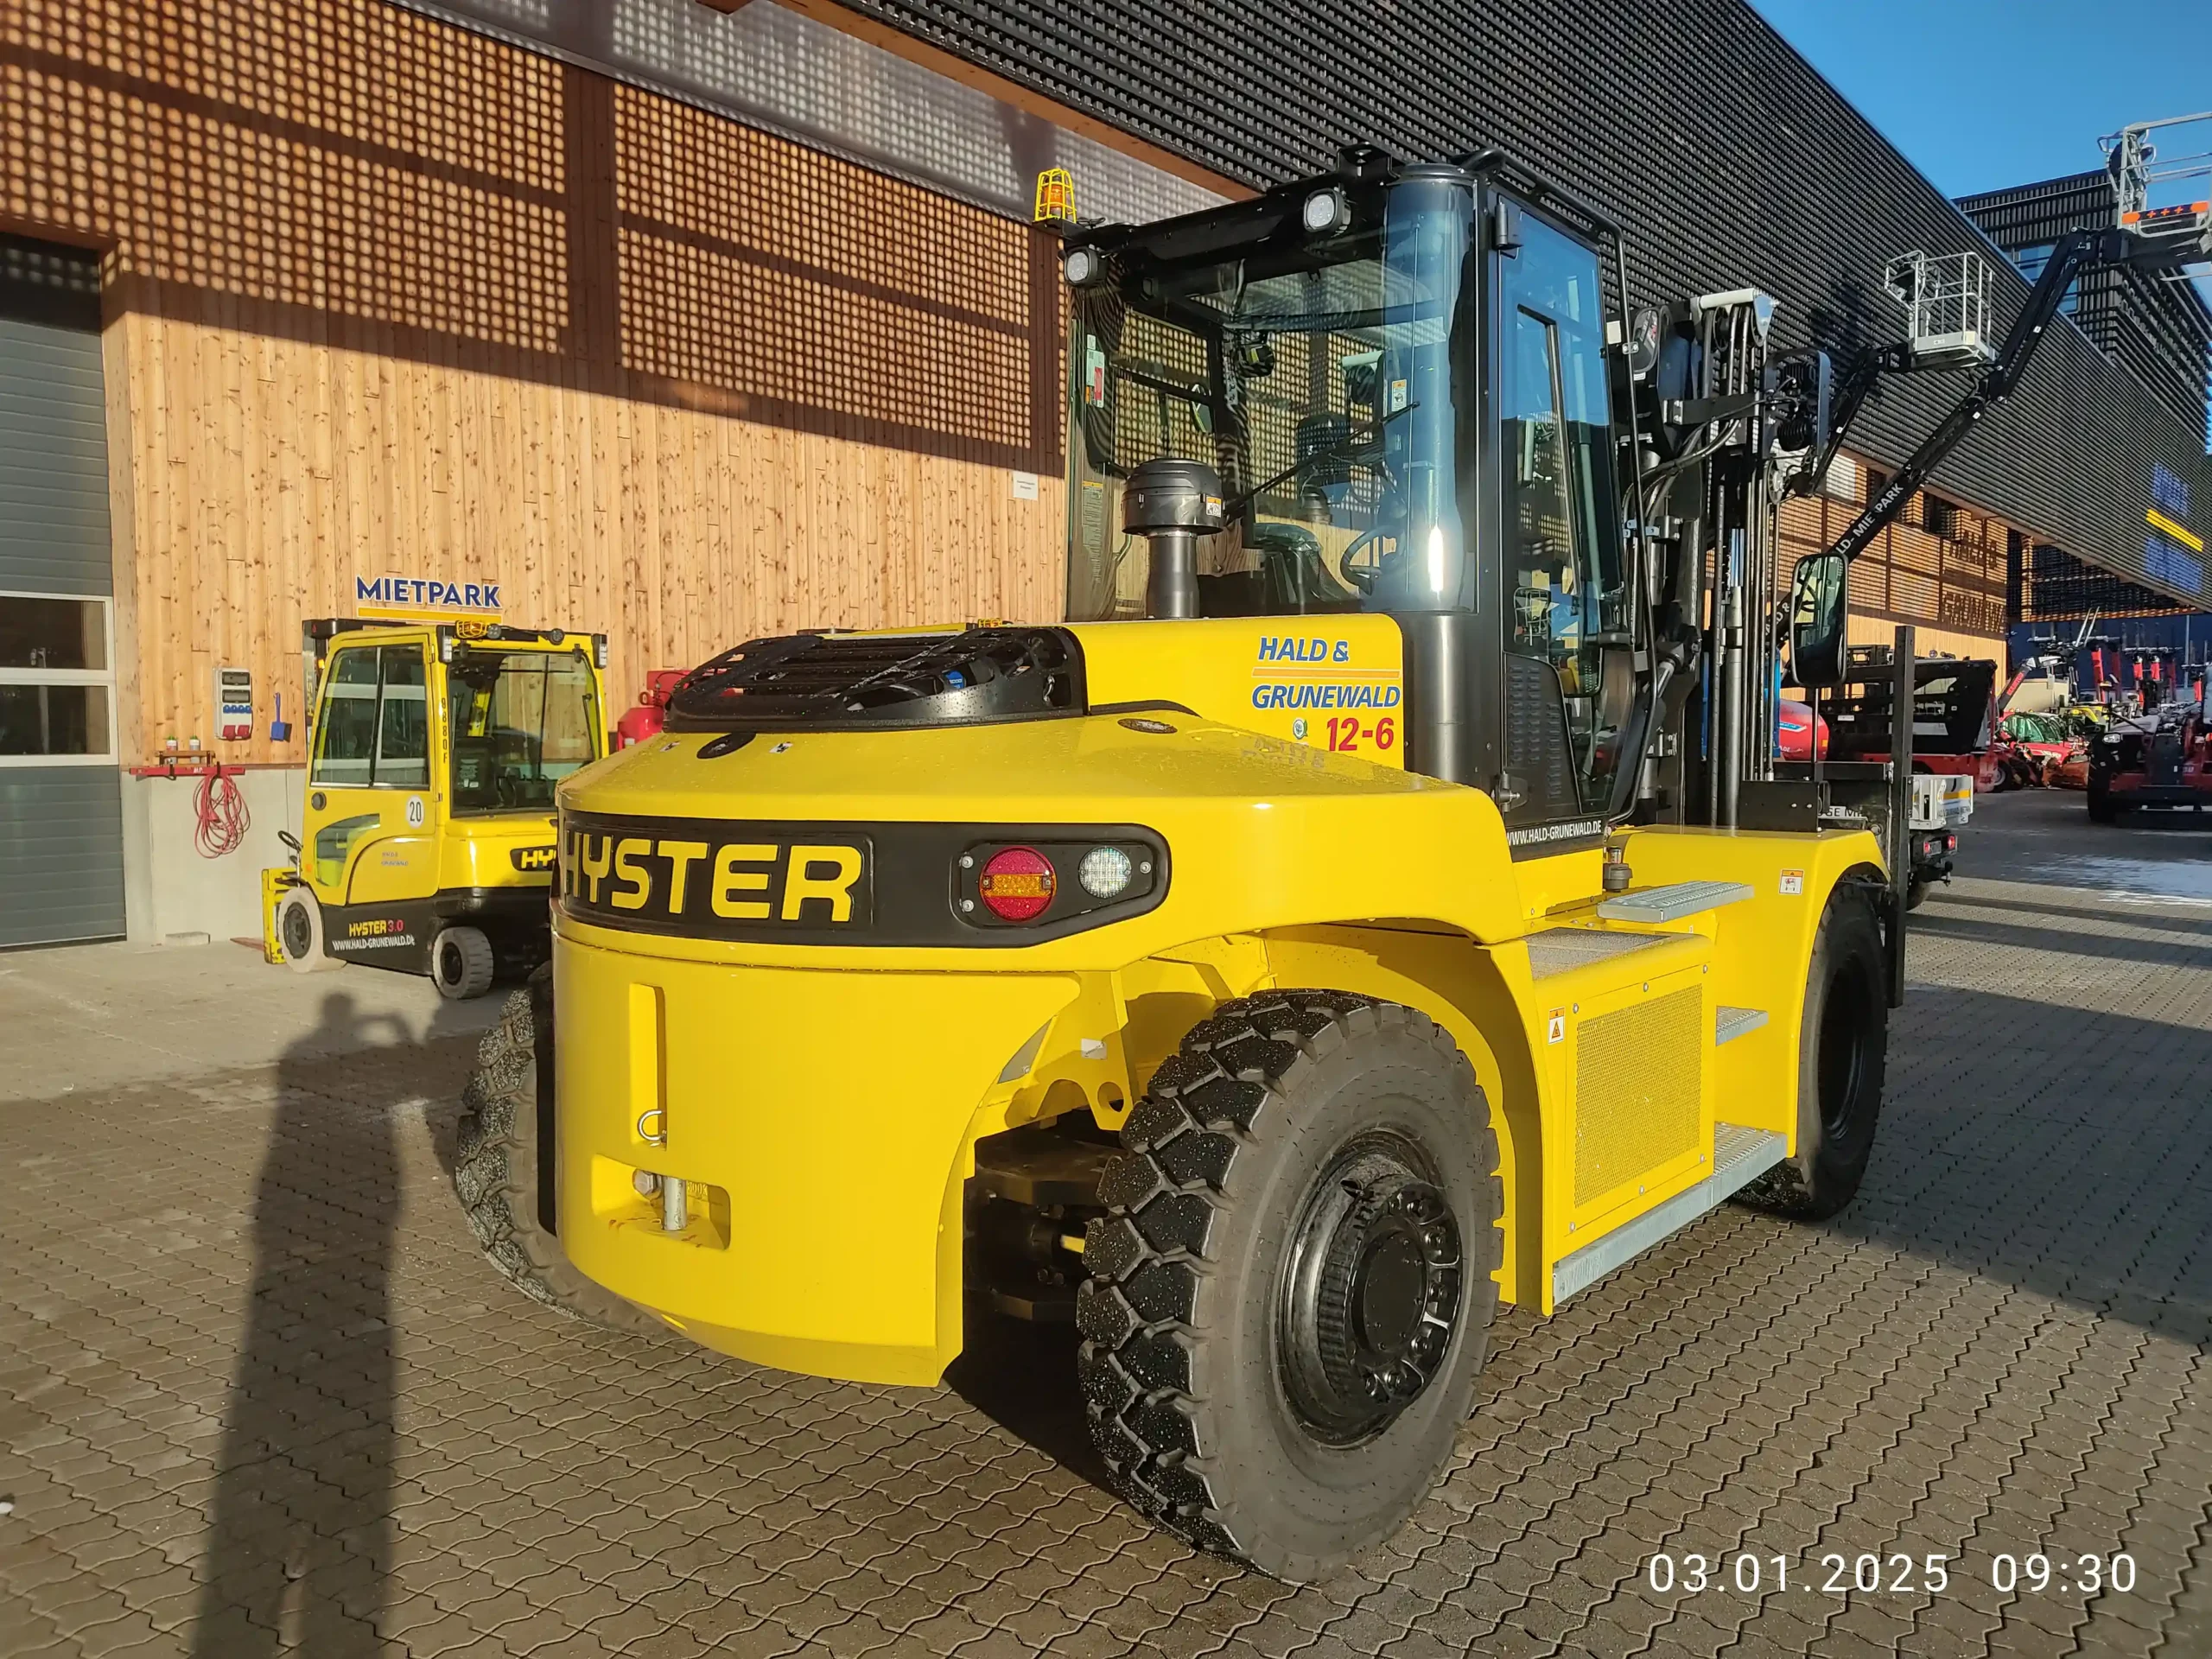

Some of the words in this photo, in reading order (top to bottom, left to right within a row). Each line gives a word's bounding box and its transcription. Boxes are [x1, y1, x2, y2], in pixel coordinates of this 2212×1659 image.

[1853, 483, 1904, 538] MIEPARK
[356, 575, 501, 608] MIETPARK
[1257, 637, 1328, 662] HALD
[1332, 640, 1349, 663] &
[1252, 684, 1401, 709] GRUNEWALD
[1326, 717, 1395, 752] 12-6
[410, 801, 422, 822] 20
[564, 829, 863, 923] HYSTER
[348, 919, 387, 938] HYSTER
[387, 918, 404, 933] 3.0
